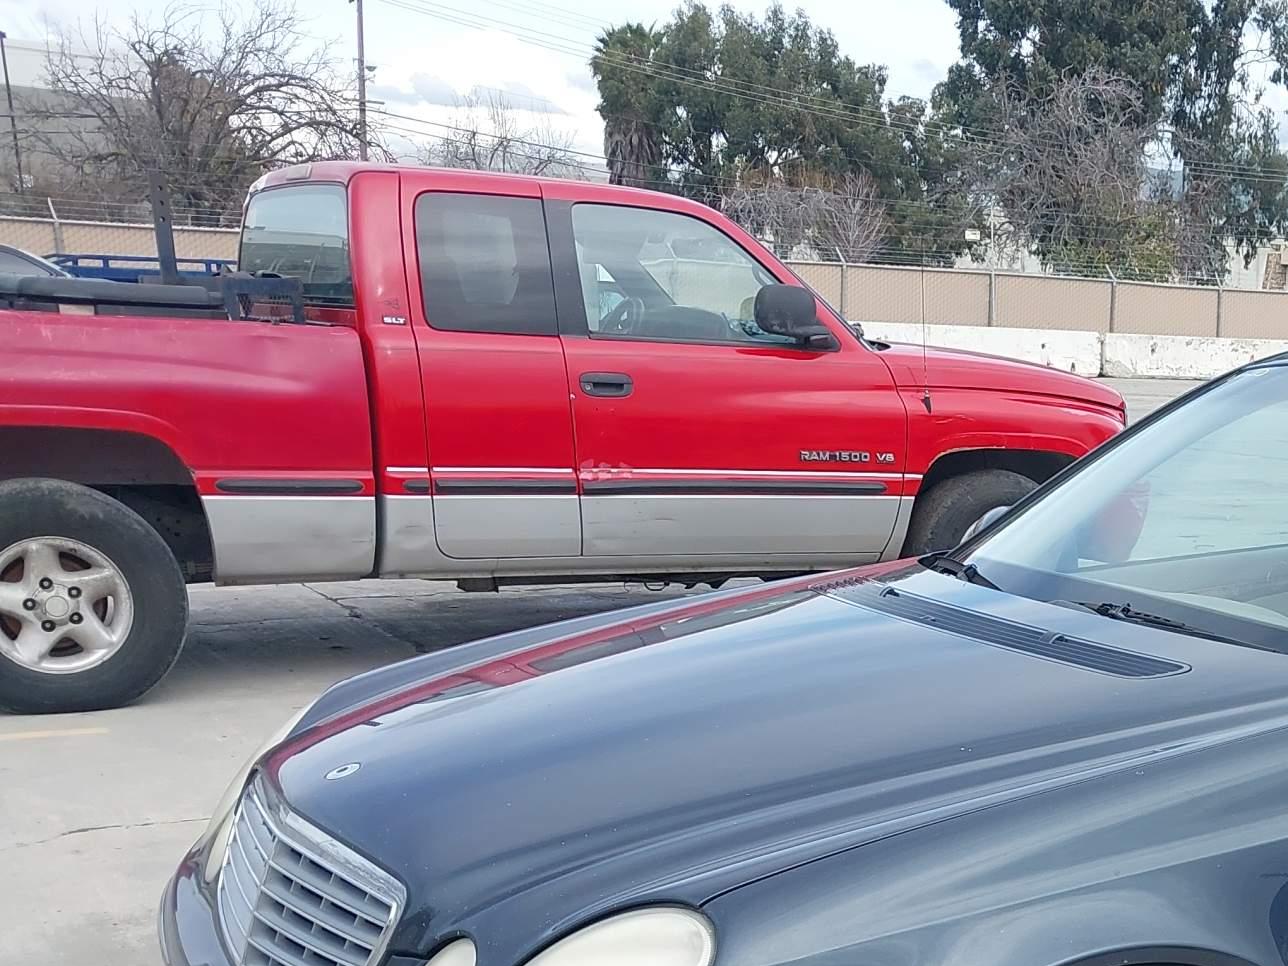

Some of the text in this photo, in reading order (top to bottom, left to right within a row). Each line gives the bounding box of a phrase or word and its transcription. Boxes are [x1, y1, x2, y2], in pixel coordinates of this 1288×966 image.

[383, 316, 406, 324] SLT
[800, 450, 830, 461] RAM
[835, 451, 870, 462] 1500
